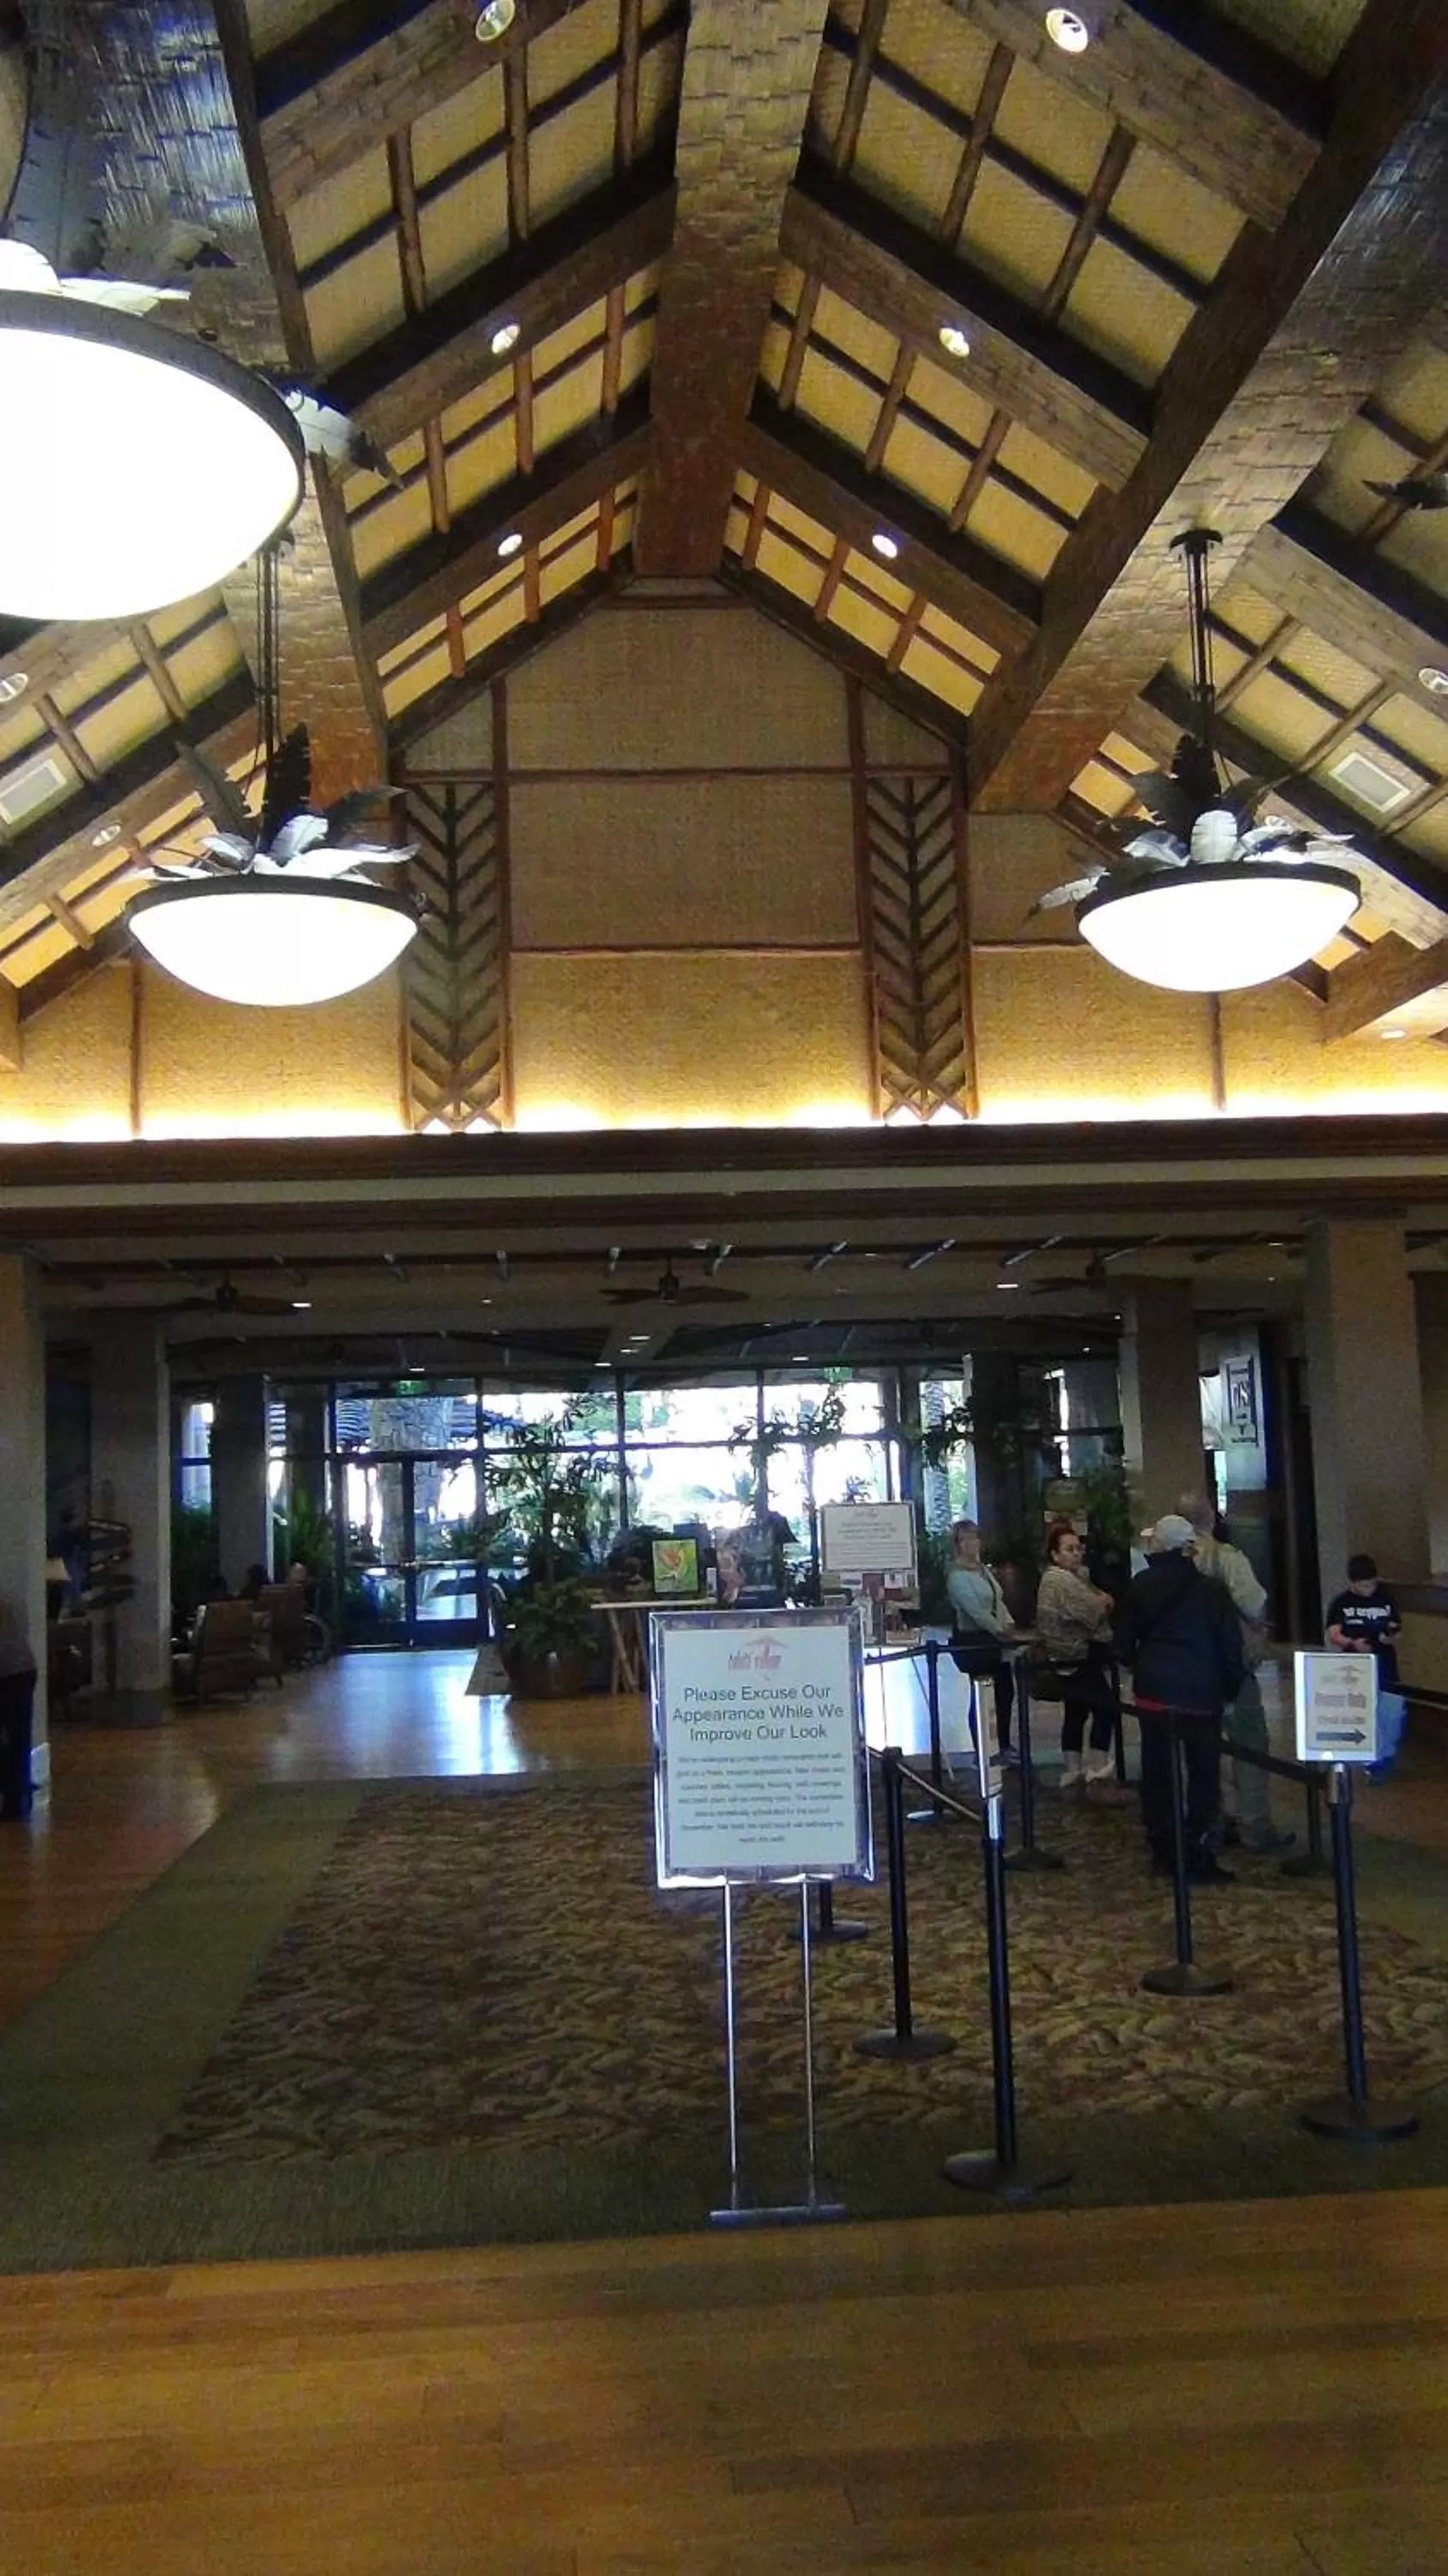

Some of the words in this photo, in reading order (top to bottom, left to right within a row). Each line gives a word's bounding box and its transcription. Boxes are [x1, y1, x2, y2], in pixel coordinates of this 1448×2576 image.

[684, 1686, 736, 1702] Please
[741, 1686, 797, 1700] Excuse
[802, 1684, 830, 1699] Our
[672, 1707, 764, 1724] Appearance
[769, 1704, 813, 1718] While
[818, 1704, 844, 1717] We
[690, 1728, 751, 1744] Improve
[757, 1725, 785, 1740] Our
[789, 1723, 828, 1739] Look
